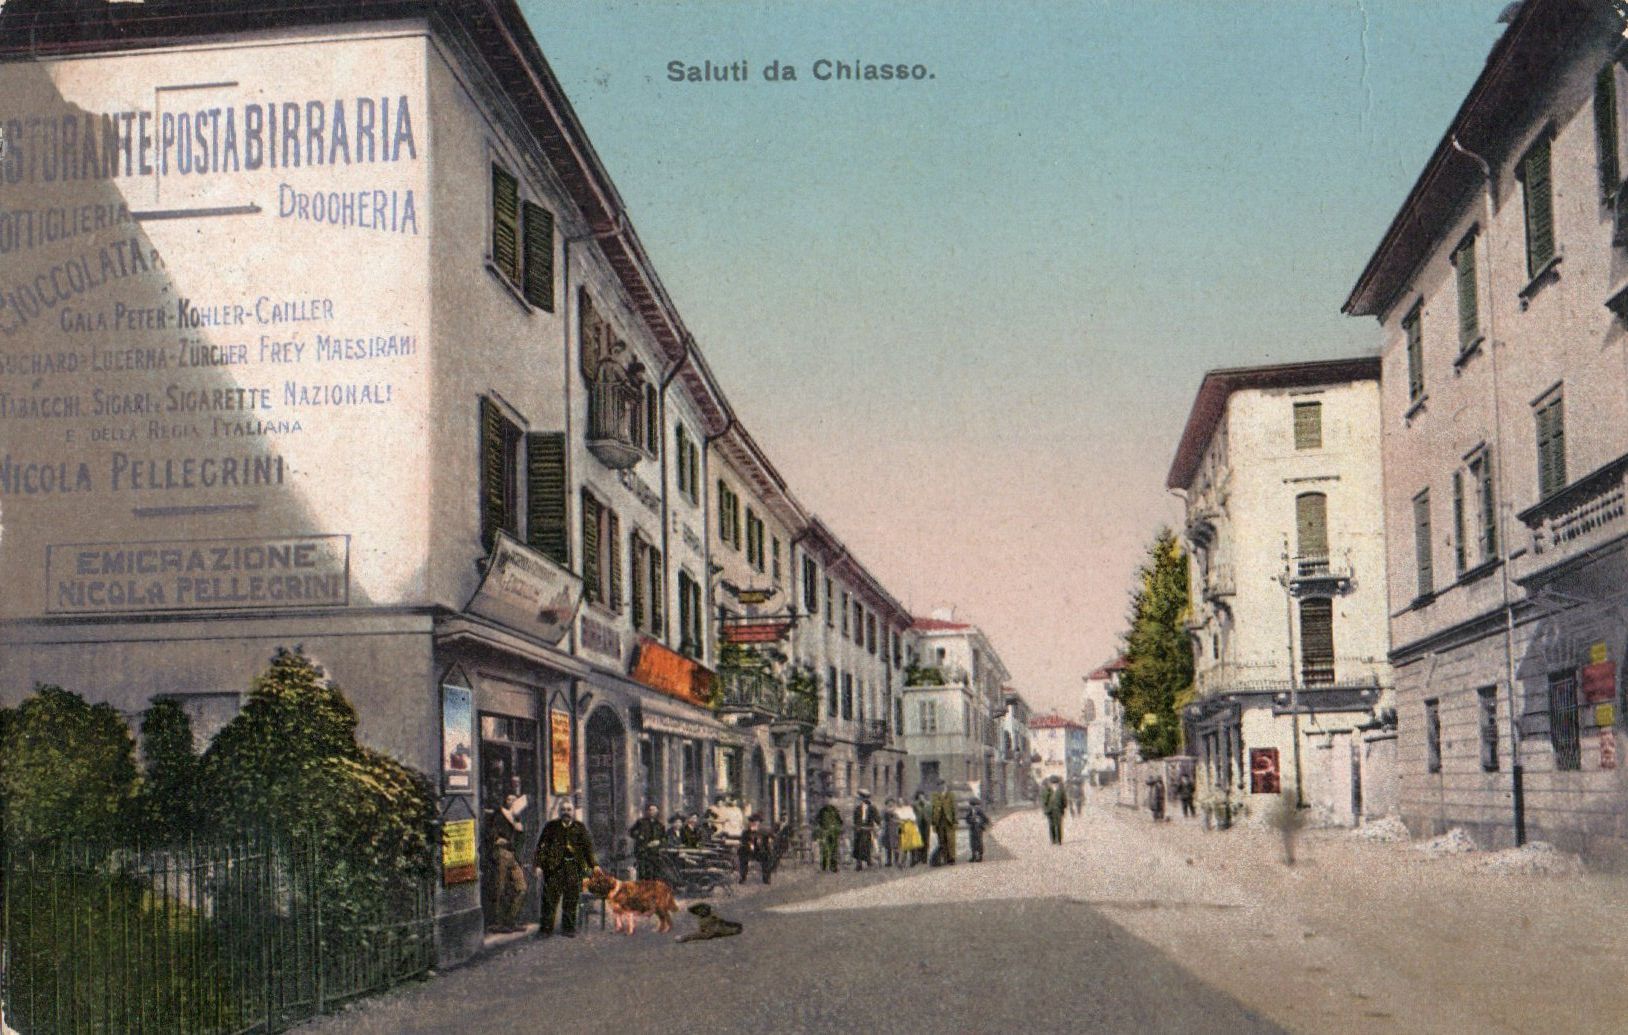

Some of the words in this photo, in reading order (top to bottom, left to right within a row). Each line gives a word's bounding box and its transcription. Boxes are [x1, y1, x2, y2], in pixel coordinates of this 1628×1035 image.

[0, 110, 153, 184] STORANTE
[160, 107, 240, 176] POSTA
[244, 95, 417, 171] BIRRARIA
[166, 384, 272, 412] SIGARETTE
[211, 417, 302, 437] ITALIANA
[111, 451, 284, 492] PELLEGRINI
[77, 543, 316, 575] EMIGRAZIONE
[58, 579, 165, 606] NICOLA
[176, 573, 341, 603] PELLEGRINI
